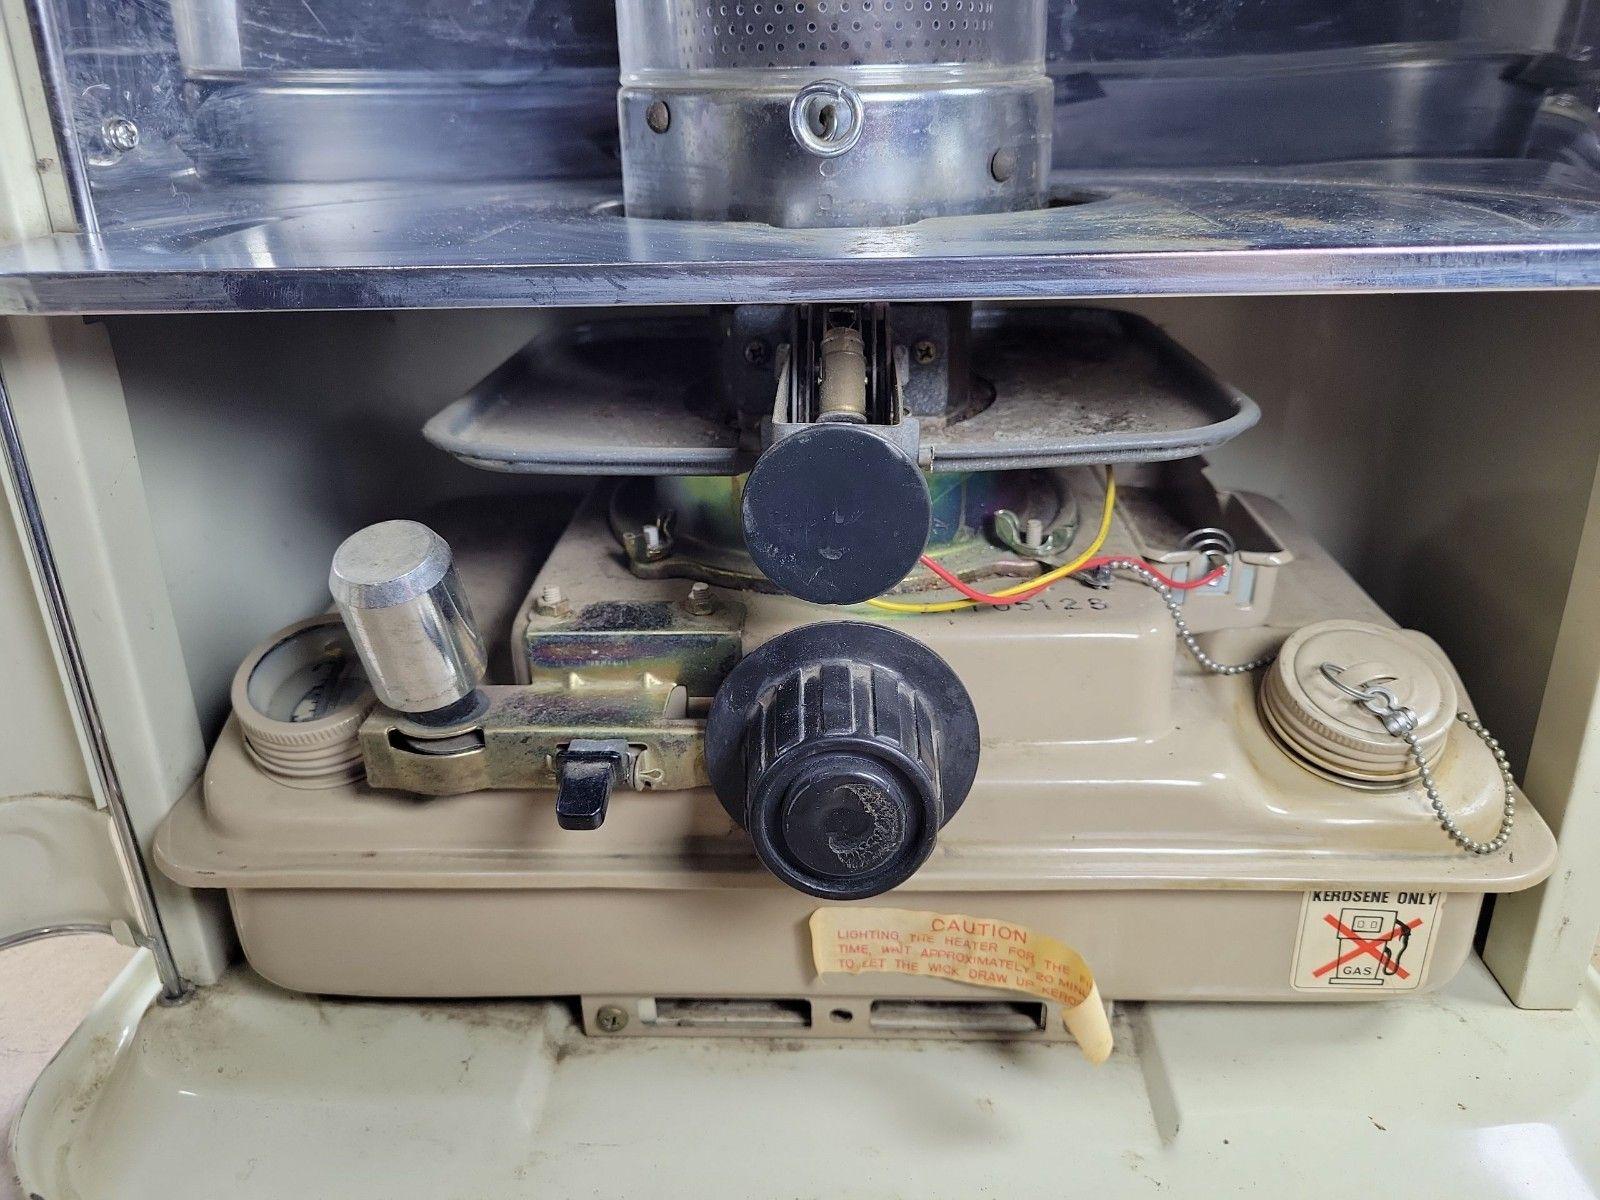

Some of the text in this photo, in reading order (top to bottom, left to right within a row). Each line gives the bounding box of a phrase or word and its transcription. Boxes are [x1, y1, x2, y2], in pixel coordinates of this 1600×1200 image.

[1312, 891, 1437, 904] KEROSENE ONLY
[931, 918, 1027, 943] CAUTION
[838, 930, 899, 941] LIGHTING
[910, 933, 935, 942] THE
[945, 936, 998, 952] HEATER
[1008, 946, 1035, 963] FOR
[1044, 959, 1070, 975] THE
[921, 948, 1030, 972] APPROXIMATELY
[839, 959, 854, 969] TO
[895, 958, 919, 971] THE
[928, 962, 959, 976] WICK
[969, 968, 1007, 983] DRAW
[1016, 976, 1033, 987] UP
[1343, 966, 1372, 976] GAS
